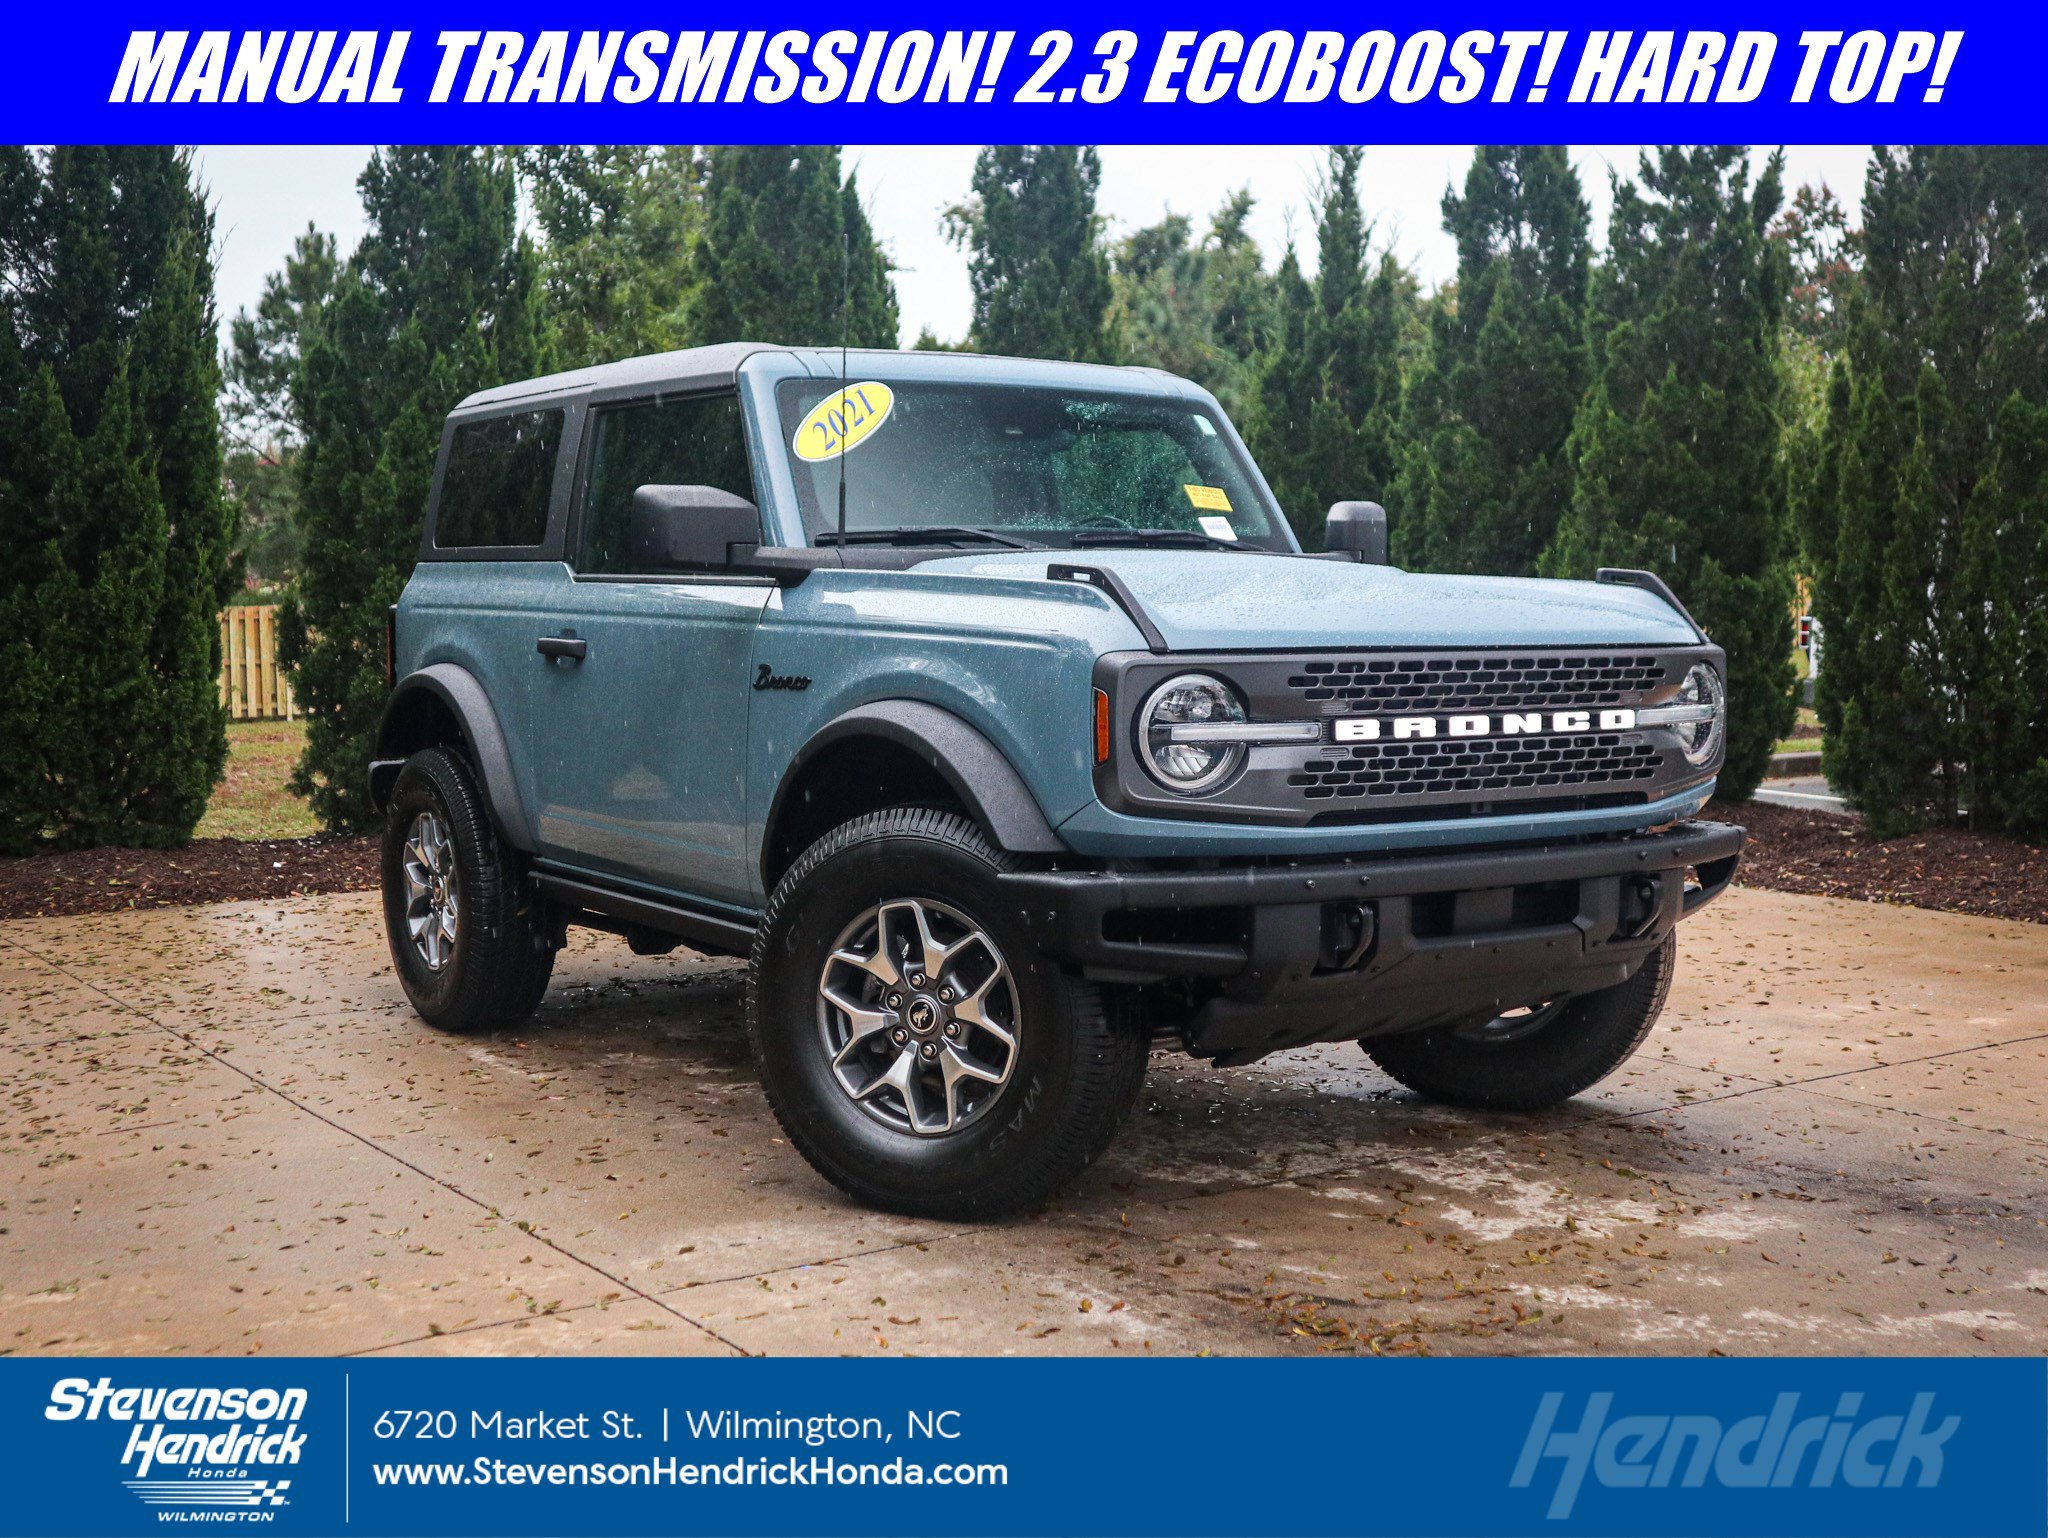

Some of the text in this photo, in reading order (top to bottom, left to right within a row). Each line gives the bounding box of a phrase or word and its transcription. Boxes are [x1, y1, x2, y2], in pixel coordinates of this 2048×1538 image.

[812, 388, 875, 451] 2021
[752, 663, 812, 691] Bronco
[1334, 708, 1636, 742] BRONCO
